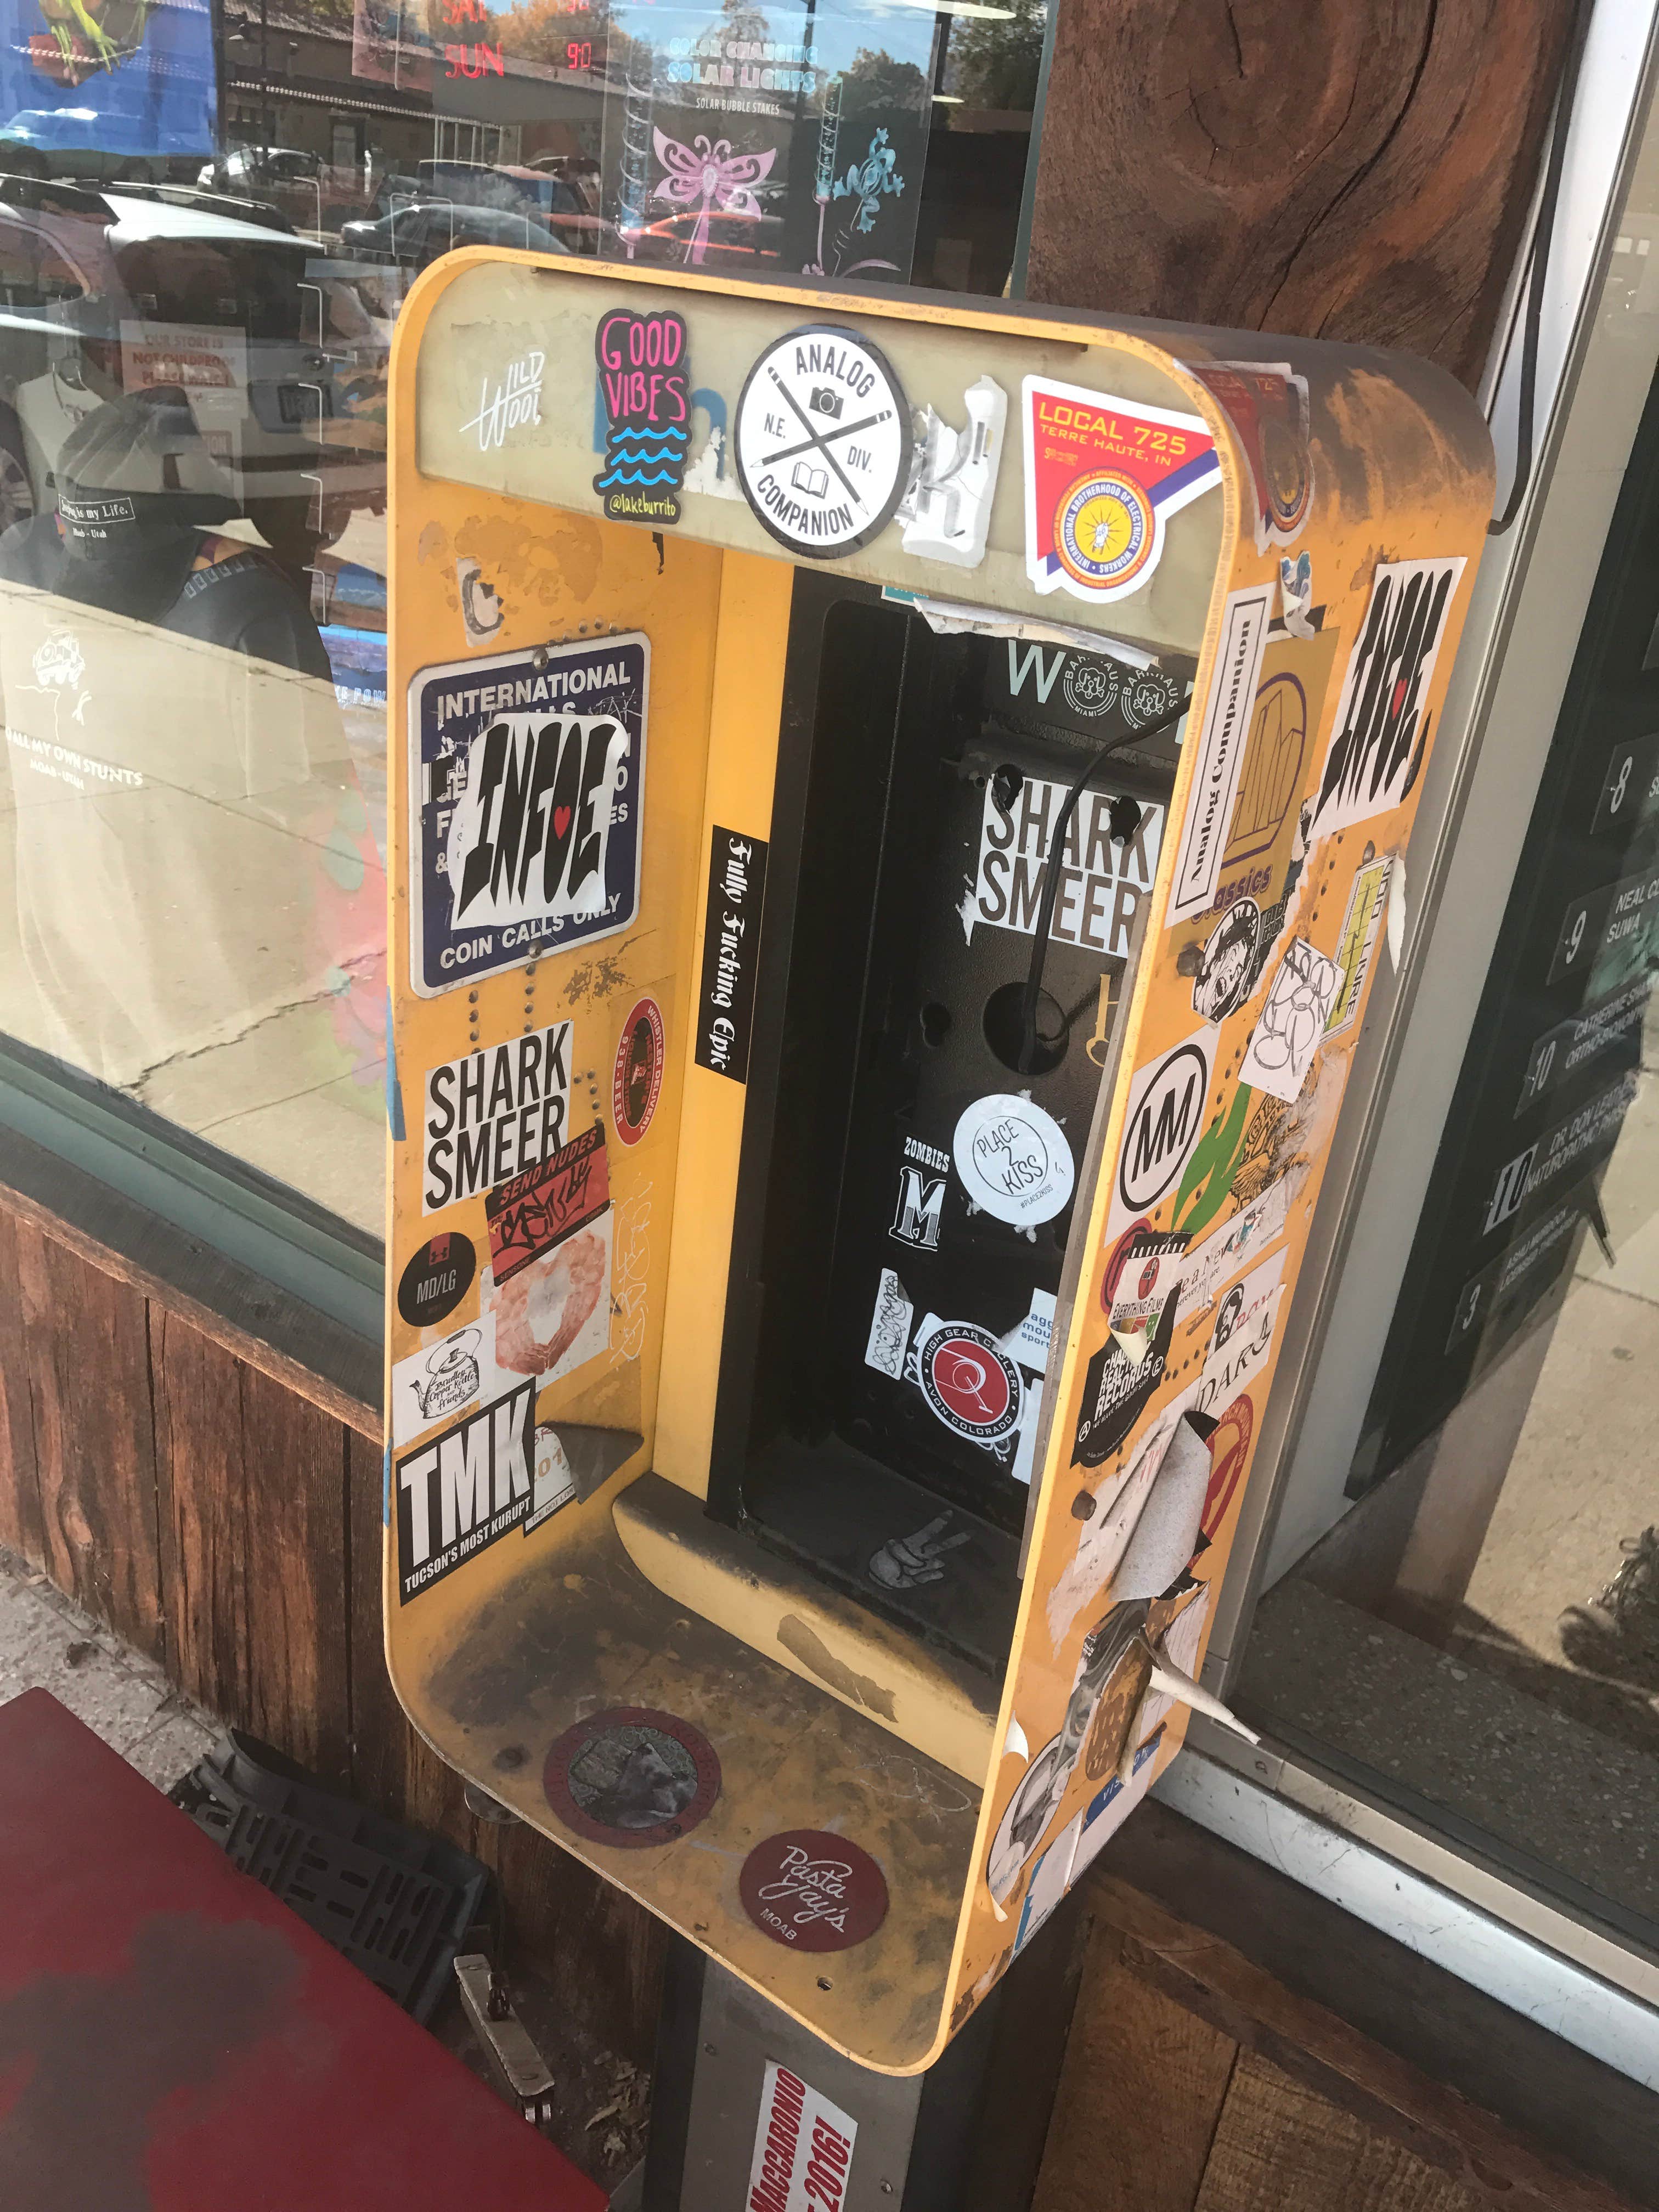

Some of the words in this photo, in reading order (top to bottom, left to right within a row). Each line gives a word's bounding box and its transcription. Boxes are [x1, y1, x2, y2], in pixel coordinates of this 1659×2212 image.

[445, 42, 504, 79] SUN
[669, 37, 721, 58] COLOR
[726, 41, 819, 64] CHANGING
[667, 61, 734, 86] SOLAR
[741, 66, 816, 93] LIGHTS
[696, 98, 719, 110] SOLAR
[721, 99, 750, 112] BUBBLE
[753, 102, 780, 115] STAKES
[174, 335, 210, 348] STORE
[602, 318, 681, 369] GOOD
[606, 371, 685, 421] VIBES
[796, 344, 875, 398] ANALOG
[764, 413, 786, 439] N.E.
[1039, 402, 1123, 440] LOCAL
[1134, 426, 1186, 455] 725
[1040, 424, 1088, 445] TERRE
[1094, 438, 1149, 462] HAUTE,
[1155, 455, 1171, 466] IN
[848, 445, 872, 473] DIV.
[86, 509, 99, 520] my
[610, 492, 676, 517] @lakeburrito
[757, 475, 854, 537] COMPANION
[1071, 484, 1121, 513] BROTHERHOOD
[1120, 492, 1131, 504] OF
[1065, 513, 1090, 570] INTERNATIONAL
[1127, 502, 1142, 550] ELECTRICAL
[1099, 552, 1133, 574] WORKERS
[437, 661, 631, 721] INTERNATIONAL
[1074, 706, 1097, 718] MIAMI
[13, 730, 30, 750] ALL
[32, 738, 51, 757] MY
[53, 746, 81, 769] OWN
[83, 759, 143, 786] STUNTS
[1191, 790, 1224, 883] Analog
[1211, 619, 1251, 785] Companion
[1611, 756, 1633, 814] 8
[719, 837, 752, 904] Fully
[1190, 864, 1273, 925] assics
[1616, 885, 1645, 914] NEAL
[439, 934, 493, 969] COIN
[501, 914, 565, 949] CALLS
[1607, 912, 1640, 944] SUWA
[711, 911, 745, 1008] Fucking
[648, 1006, 662, 1066] WHISTLER
[709, 1017, 736, 1071] Epic
[428, 1023, 569, 1139] SHARK
[640, 1070, 661, 1133] DELIVERY
[425, 1095, 565, 1210] SMEER
[904, 1136, 951, 1173] ZOMBIES
[977, 1119, 1020, 1159] PLACE
[1001, 1146, 1019, 1167] 2
[499, 1165, 543, 1205] SEND
[547, 1130, 597, 1176] NUDES
[1001, 1154, 1044, 1195] KISS
[1492, 1151, 1533, 1224] 10
[416, 1269, 456, 1304] MD/LG
[1113, 1301, 1147, 1319] EVERYTHING
[1147, 1297, 1164, 1313] FILMS
[1463, 1284, 1481, 1330] 3
[435, 1369, 466, 1391] Bradley
[925, 1334, 943, 1361] HIGH
[945, 1329, 979, 1340] GEAR
[983, 1338, 1019, 1398] CCLERY
[430, 1384, 452, 1402] Copper
[438, 1389, 465, 1410] friends
[926, 1381, 949, 1415] AVON
[951, 1415, 1012, 1436] COLORADO
[400, 1388, 531, 1567] TMK
[405, 1543, 458, 1593] TUCSON'S
[460, 1523, 489, 1561] MOST
[492, 1496, 531, 1536] KURUPT
[780, 1845, 853, 1898] Pasta
[758, 1874, 850, 1933] Jay's
[760, 1908, 797, 1940] MOAB
[750, 2067, 806, 2212] MACCARONIO
[804, 2115, 851, 2212] 2016!
